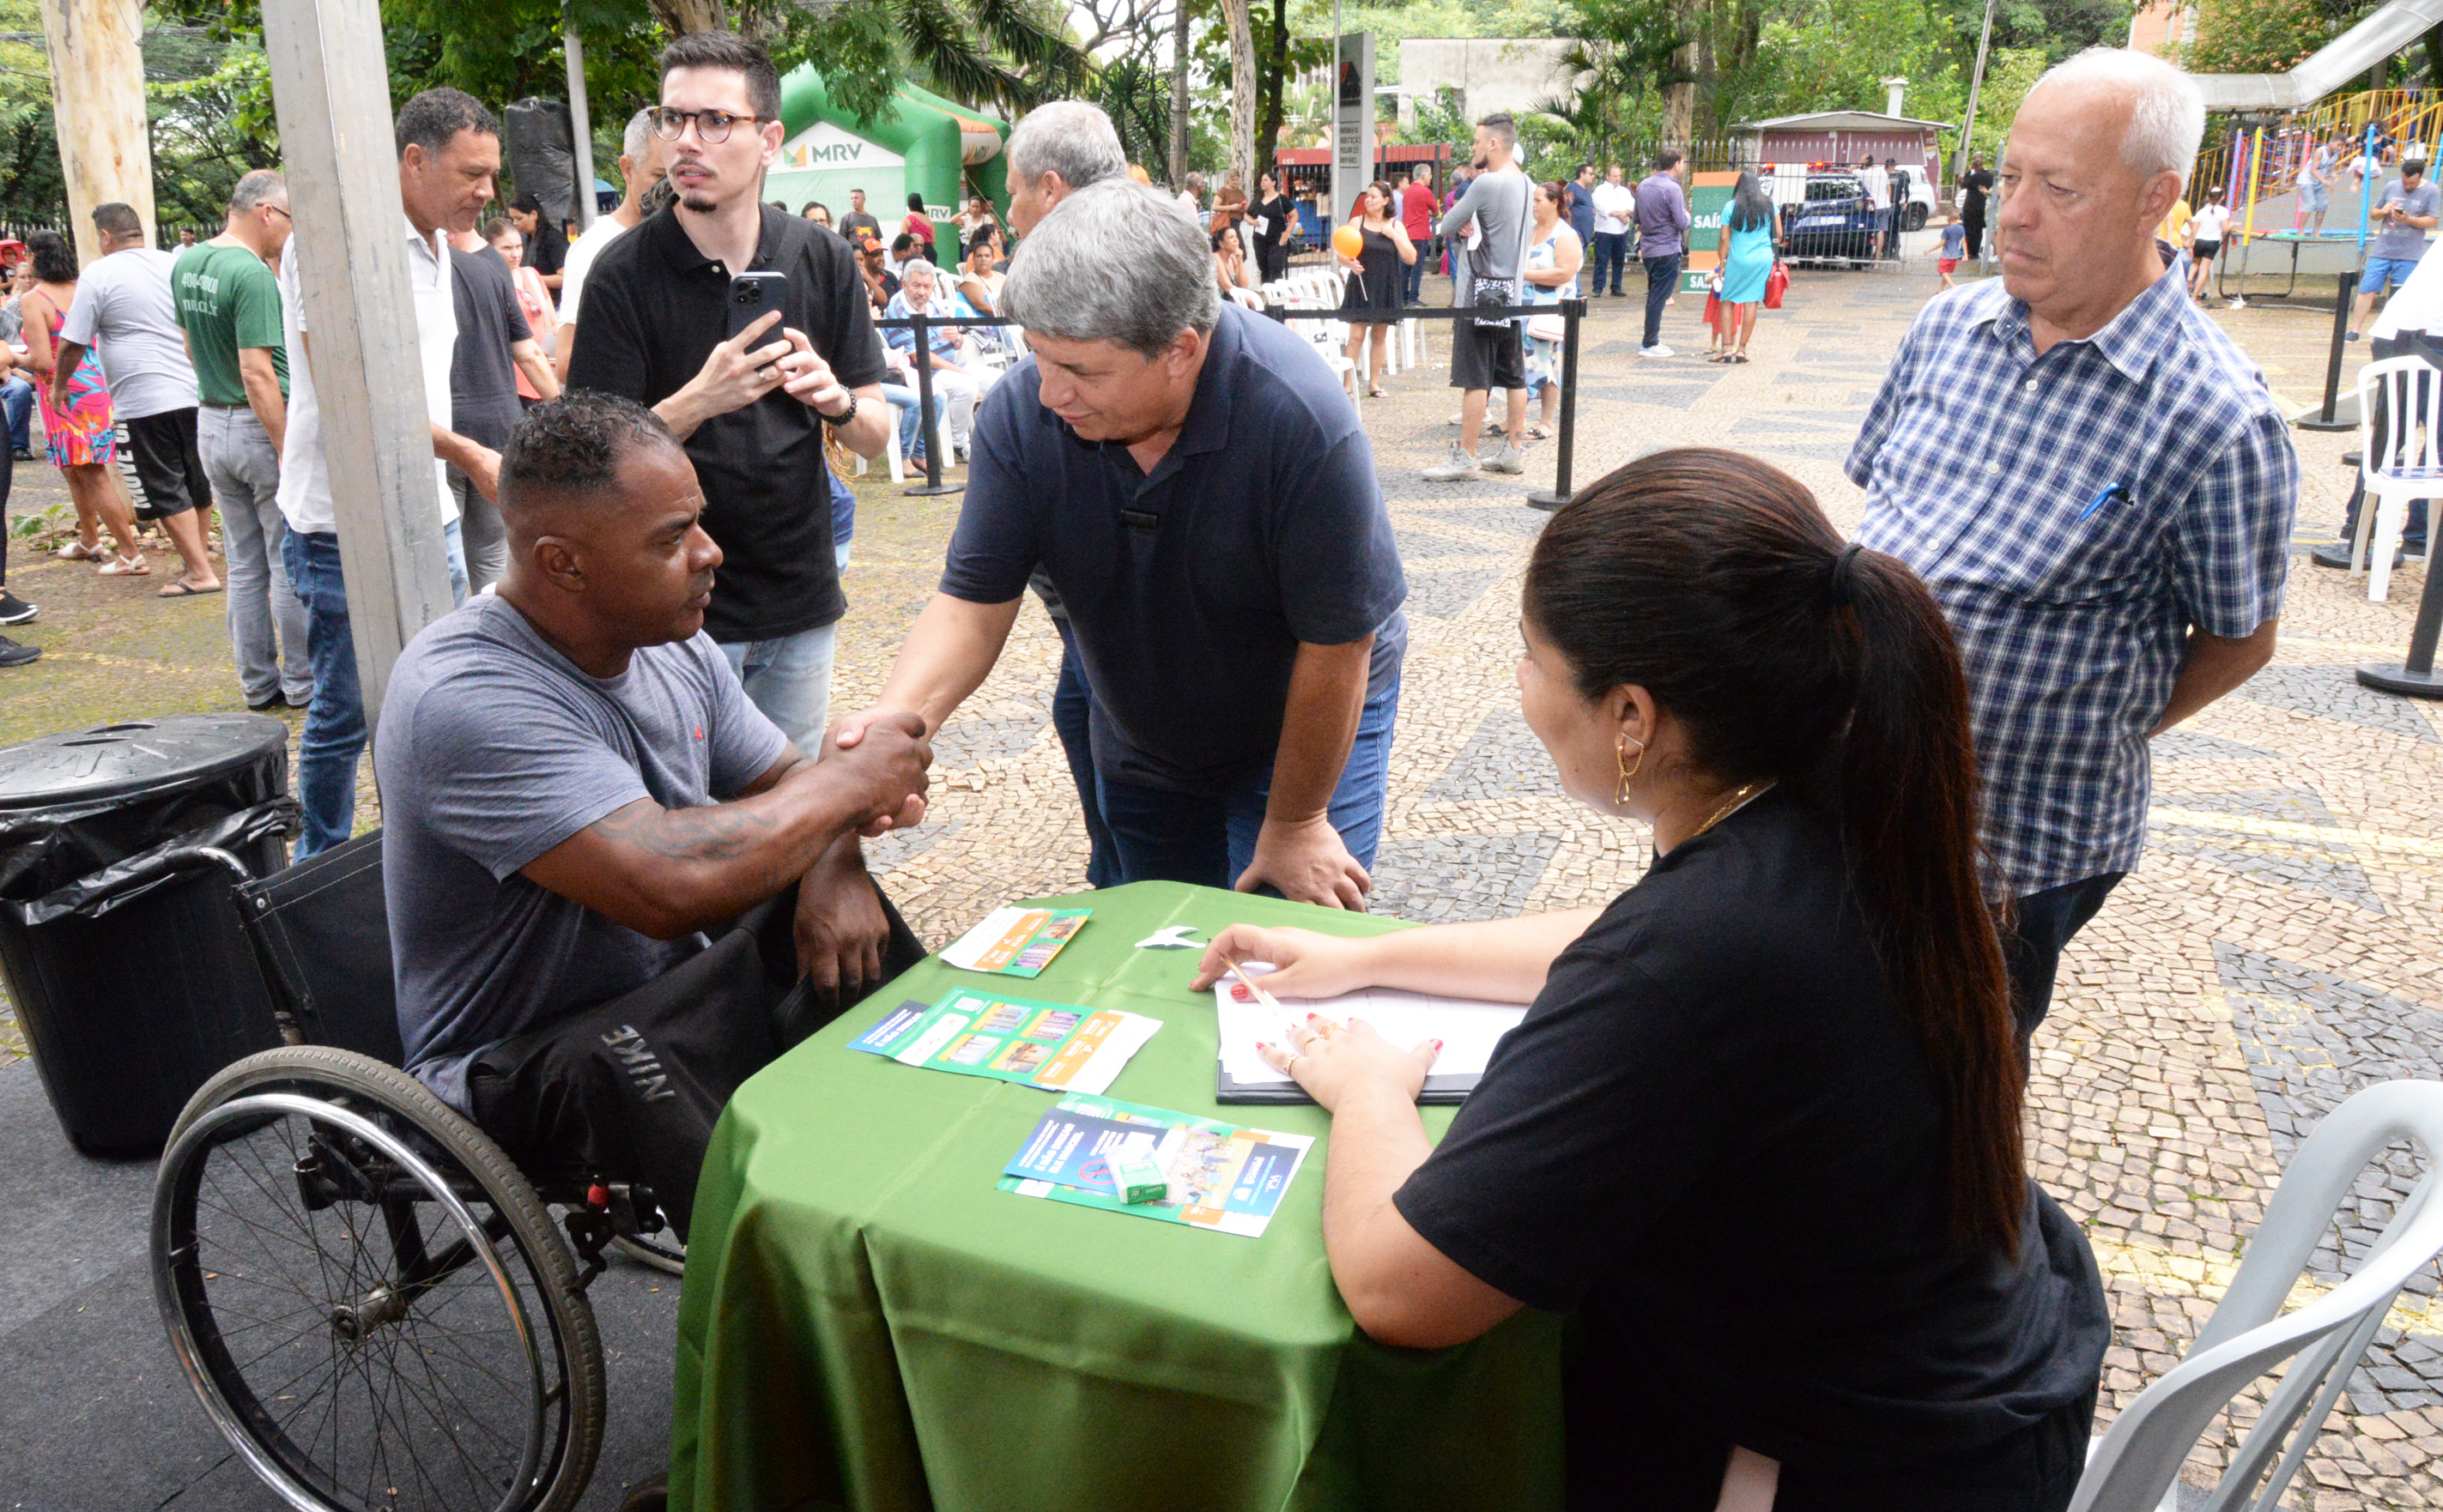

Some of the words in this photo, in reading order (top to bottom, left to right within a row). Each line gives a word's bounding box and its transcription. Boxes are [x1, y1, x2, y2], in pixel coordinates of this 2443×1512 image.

[812, 142, 863, 162] MRV
[925, 208, 949, 219] RV
[600, 1025, 676, 1103] NIKE
